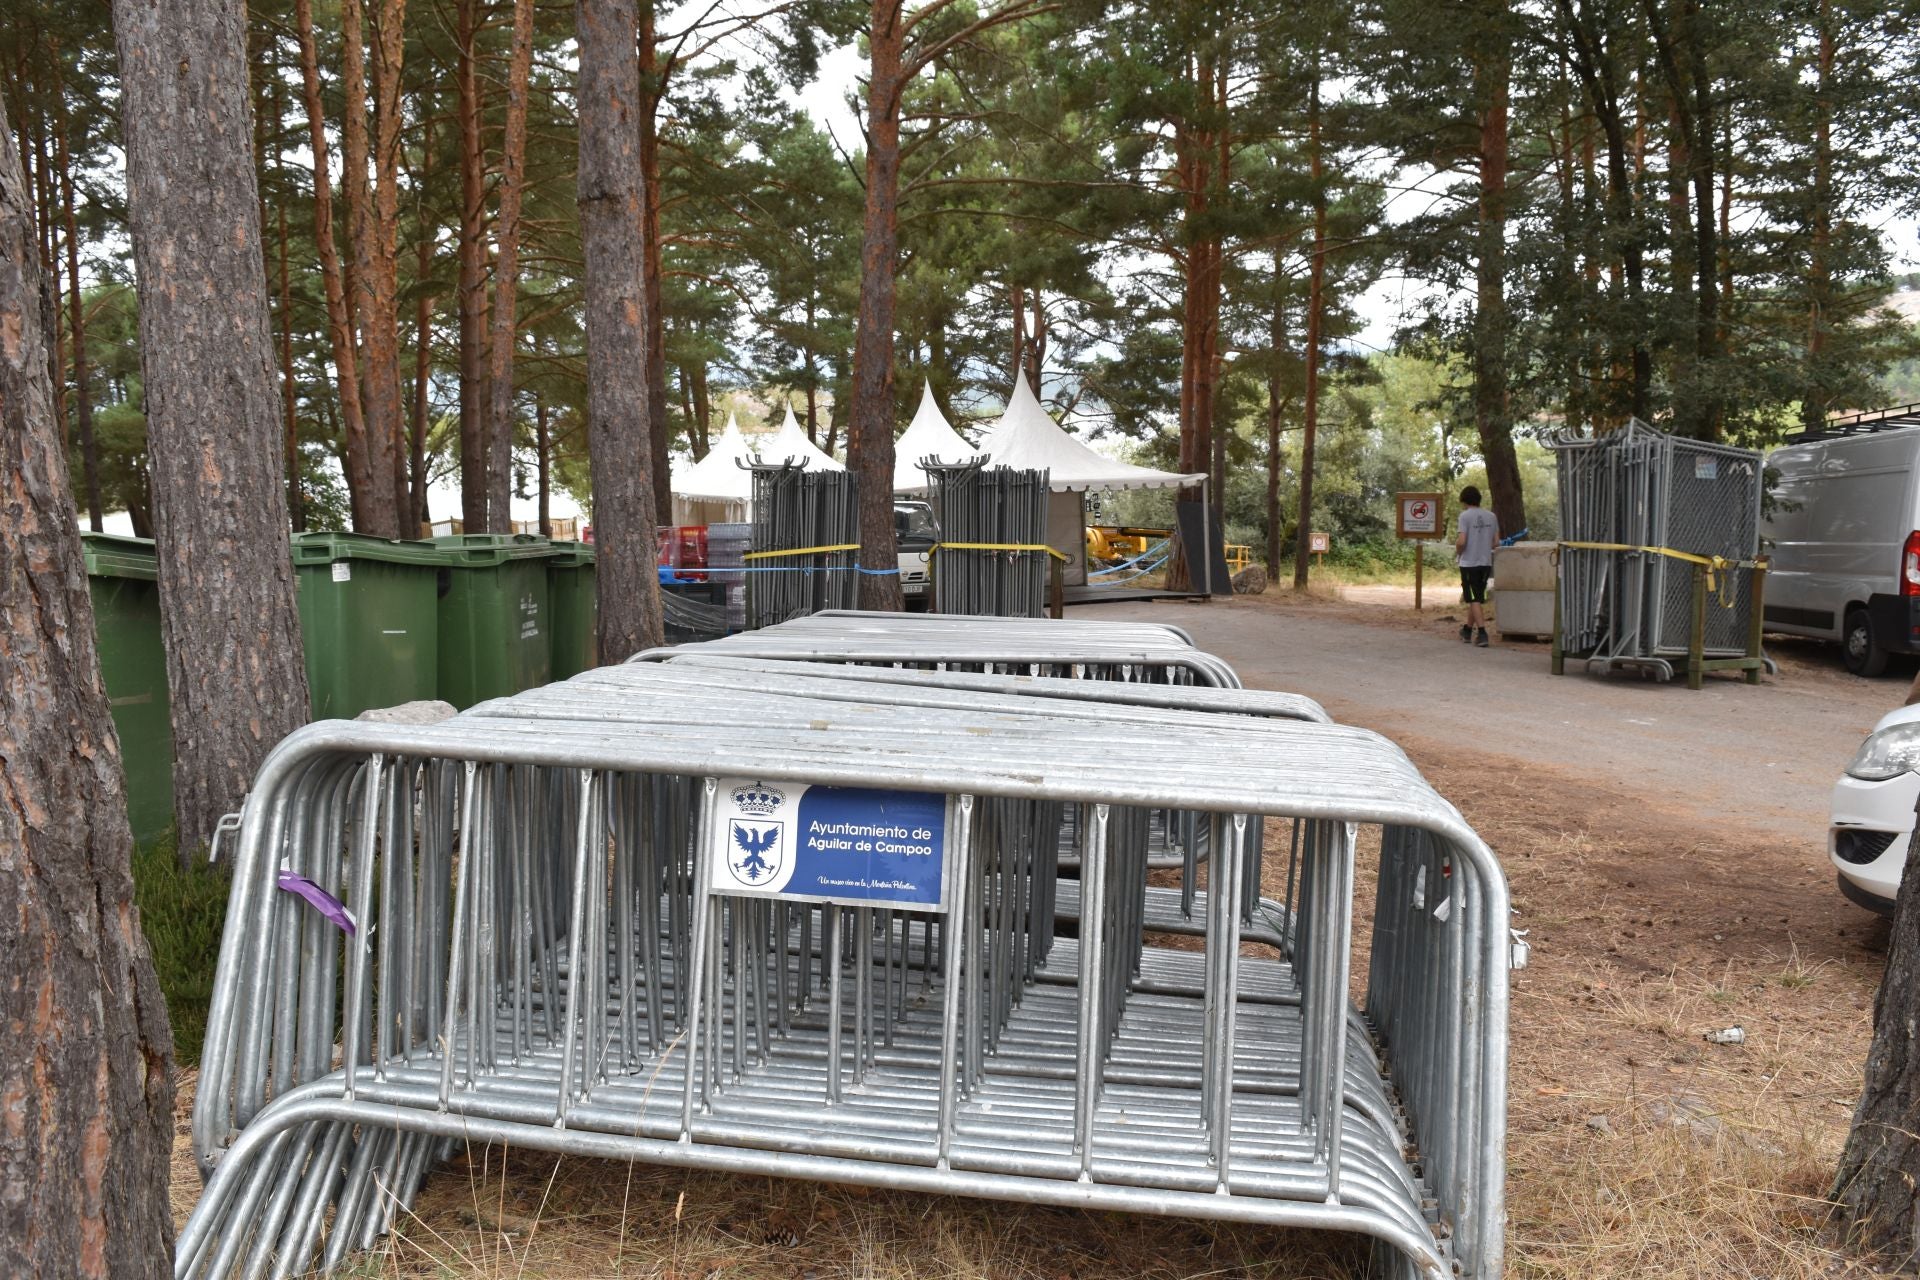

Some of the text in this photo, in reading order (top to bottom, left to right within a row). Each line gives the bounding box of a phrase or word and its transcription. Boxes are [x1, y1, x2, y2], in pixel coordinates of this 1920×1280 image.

[809, 820, 932, 840] Ayuntamiento de
[808, 836, 932, 856] Aguilar de Campoo
